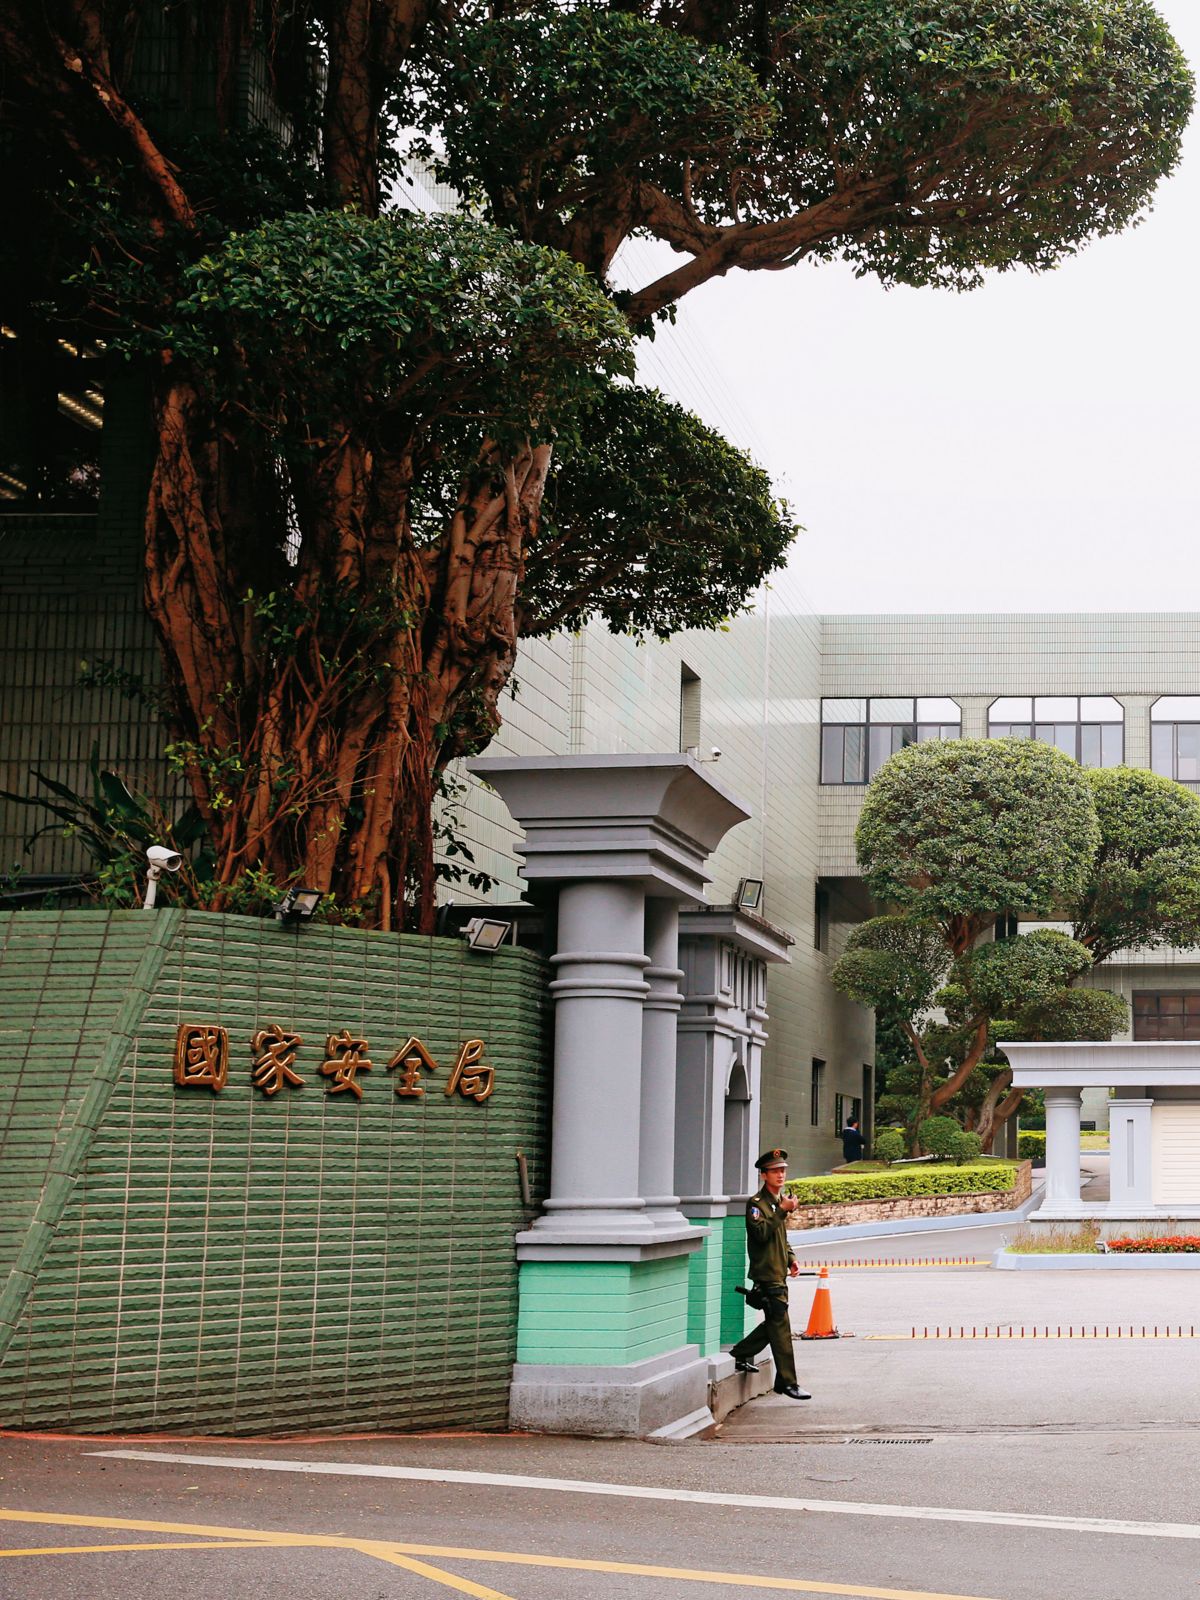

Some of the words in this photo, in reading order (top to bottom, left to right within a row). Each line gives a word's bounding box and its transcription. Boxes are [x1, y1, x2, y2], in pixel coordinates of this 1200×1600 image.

[174, 1023, 495, 1101] 國家安全局
